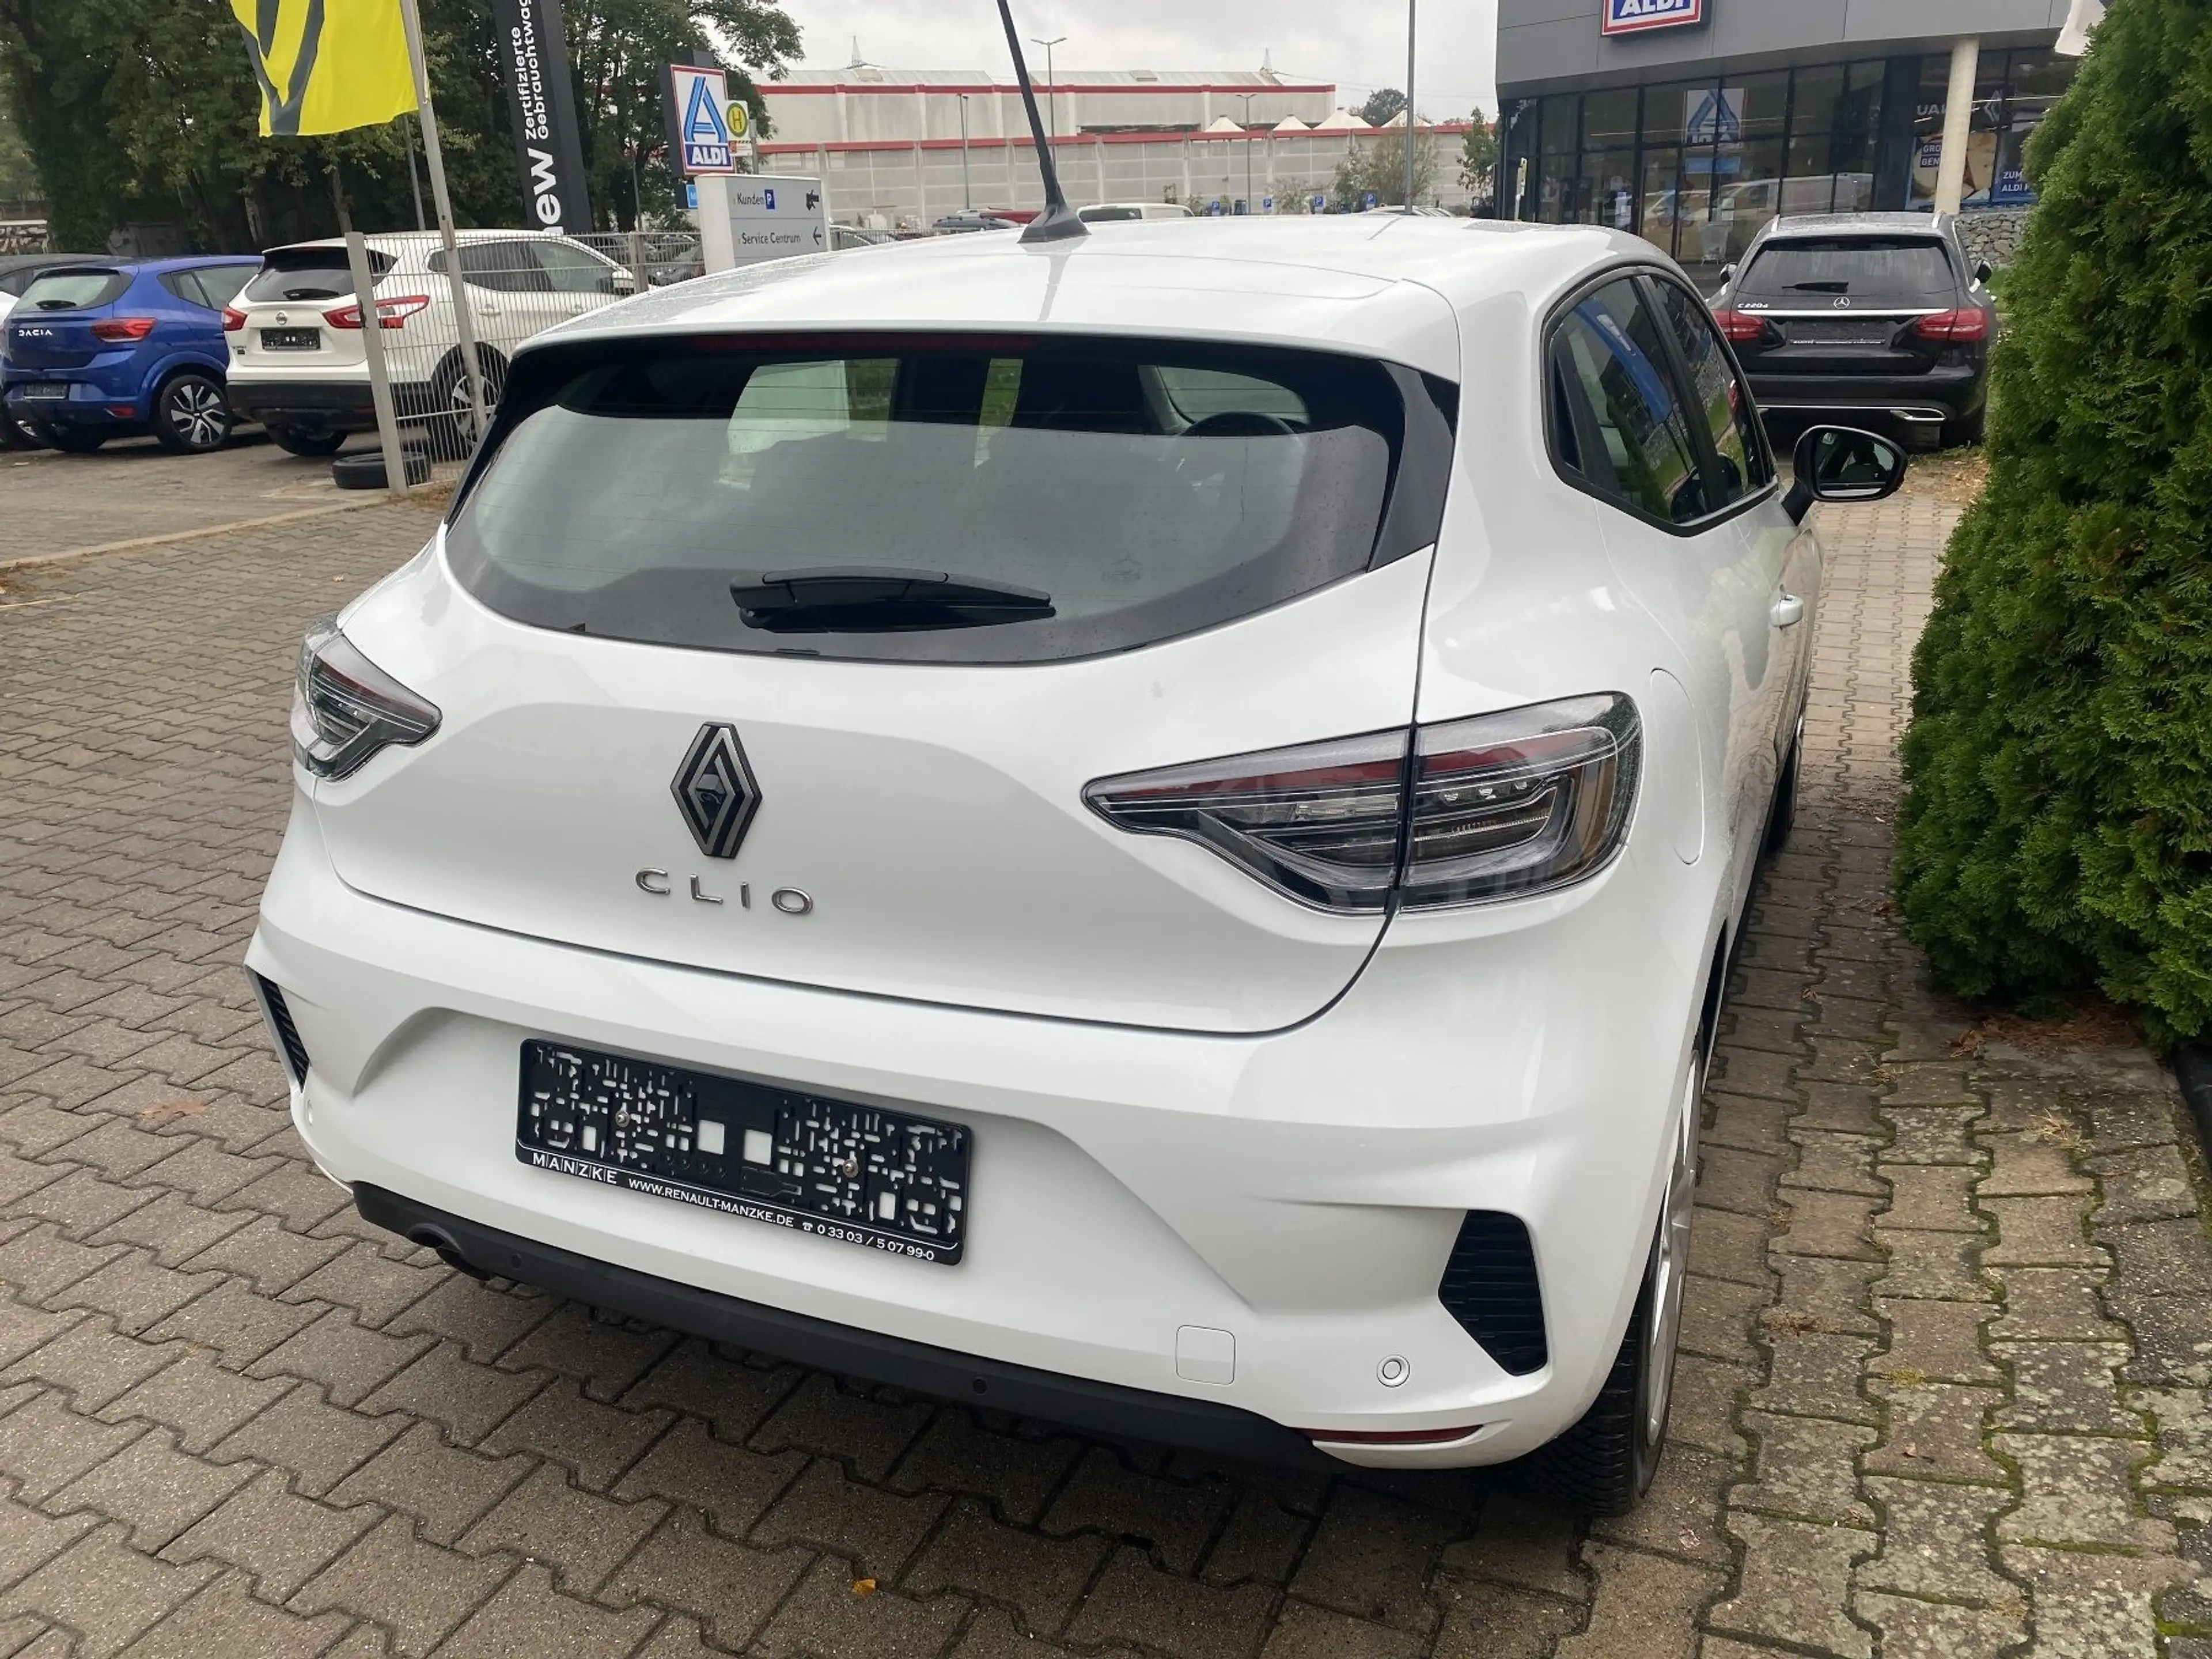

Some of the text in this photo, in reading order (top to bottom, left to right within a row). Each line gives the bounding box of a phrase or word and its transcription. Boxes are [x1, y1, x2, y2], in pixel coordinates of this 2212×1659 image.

[512, 26, 537, 140] Zertifizierte
[692, 146, 728, 164] ALDI
[2001, 184, 2022, 192] ALDI
[737, 192, 764, 205] Kunden
[741, 232, 801, 244] Service Centrum
[635, 868, 813, 915] CLIO
[532, 1152, 617, 1184] MANZKE
[628, 1178, 794, 1228] WWW.RENAULT-MANZKE.DE
